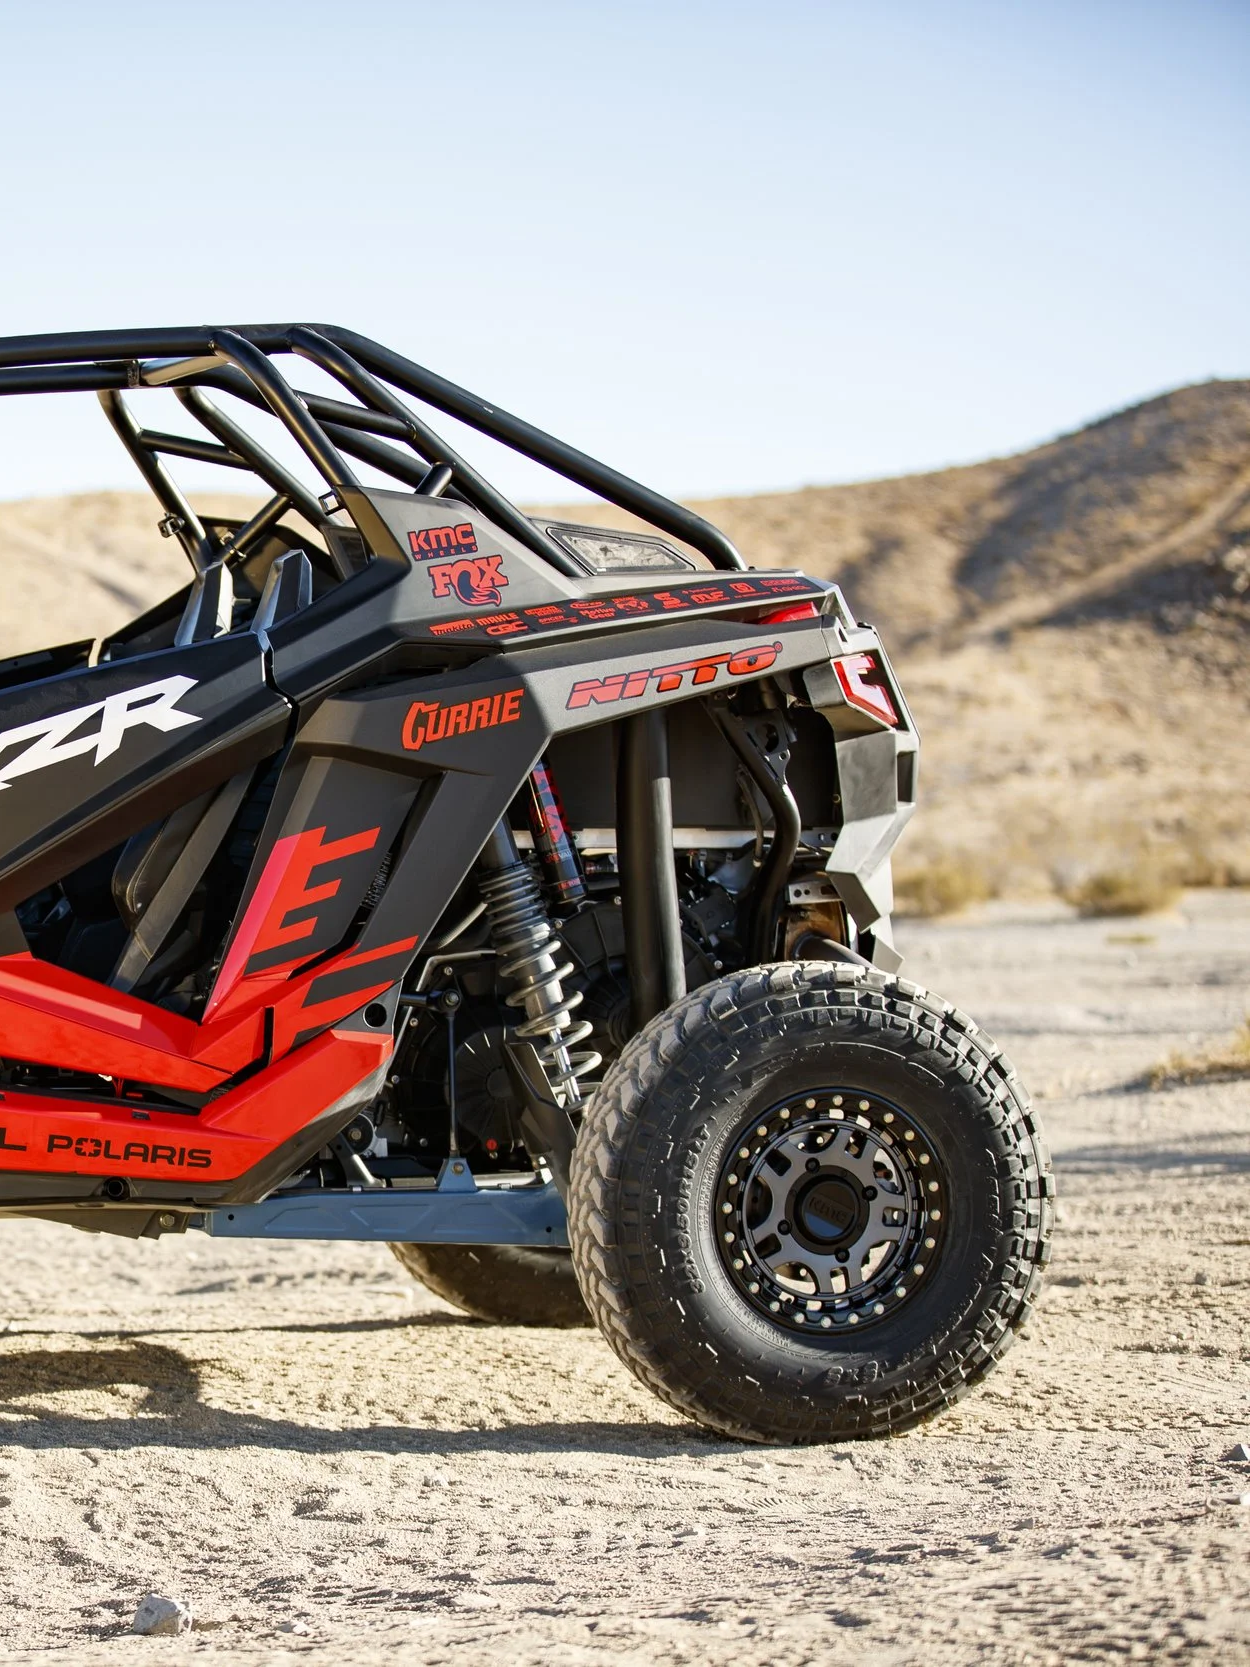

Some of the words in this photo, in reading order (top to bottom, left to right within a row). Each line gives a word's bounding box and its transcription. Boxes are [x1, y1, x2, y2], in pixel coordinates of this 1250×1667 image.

[407, 523, 476, 552] KMC
[414, 545, 478, 560] WHEELS
[428, 555, 509, 606] FOX
[476, 612, 519, 626] MAHLE
[401, 687, 525, 752] CURRIE
[47, 1134, 213, 1168] POLARIS
